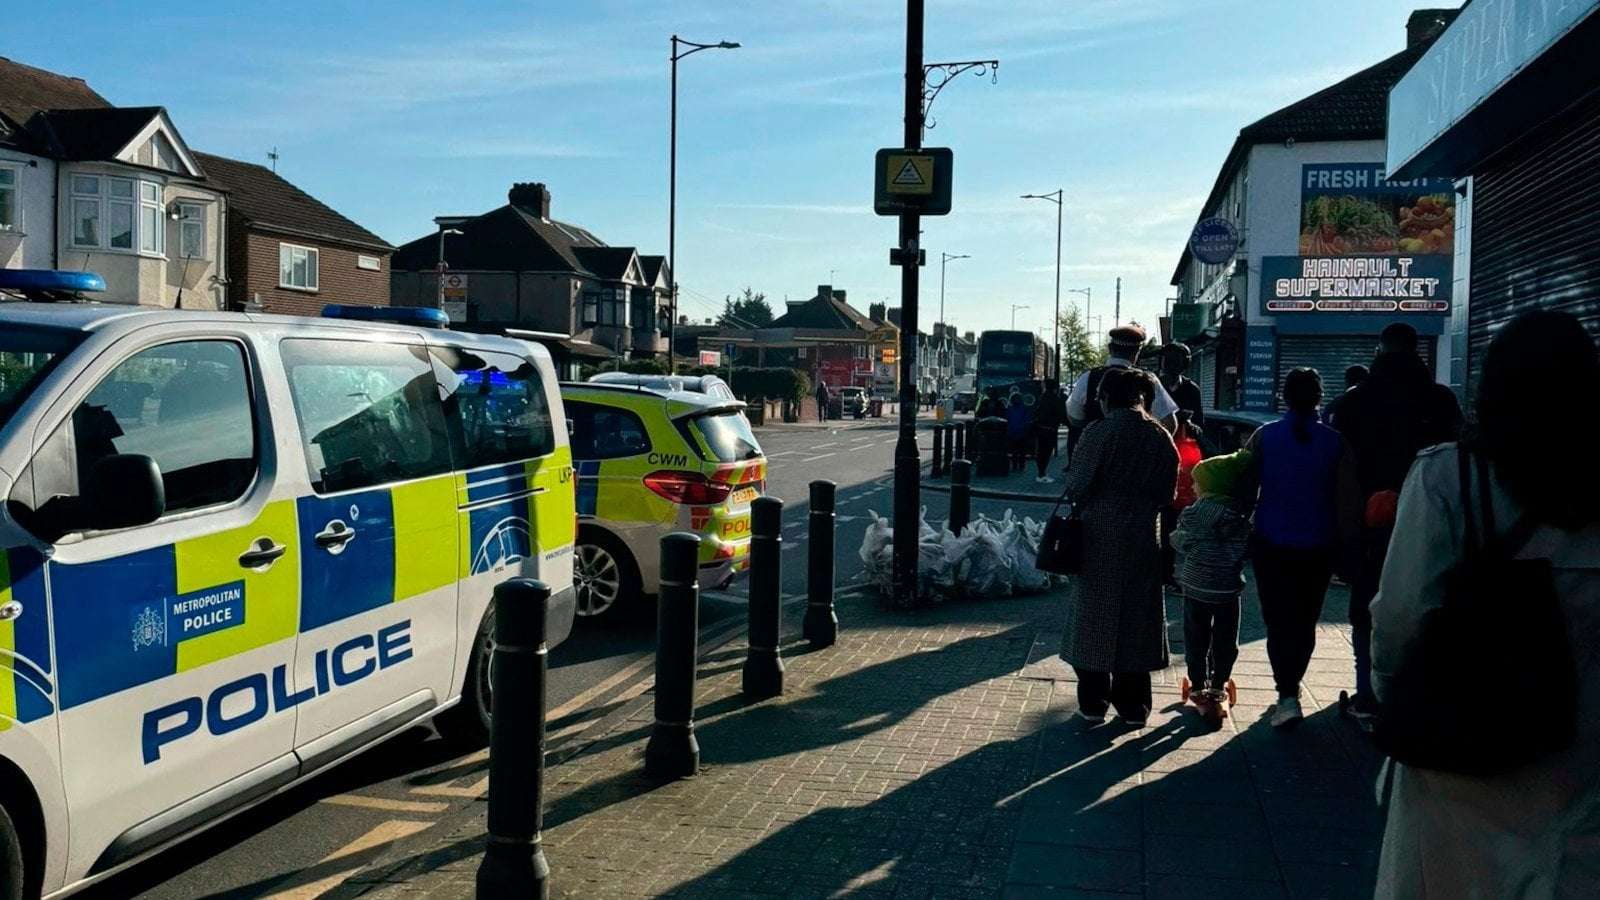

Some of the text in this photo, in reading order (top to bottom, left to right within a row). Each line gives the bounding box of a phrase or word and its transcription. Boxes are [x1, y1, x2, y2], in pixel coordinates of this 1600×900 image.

[1306, 169, 1369, 189] FRESH
[1303, 258, 1413, 278] HAINAULT
[1276, 278, 1440, 297] SUPERMARKET
[647, 452, 688, 467] CWM
[723, 518, 752, 536] POL
[173, 589, 241, 616] METROPOLITAN
[183, 607, 232, 632] POLICE
[141, 619, 413, 766] POLICE
